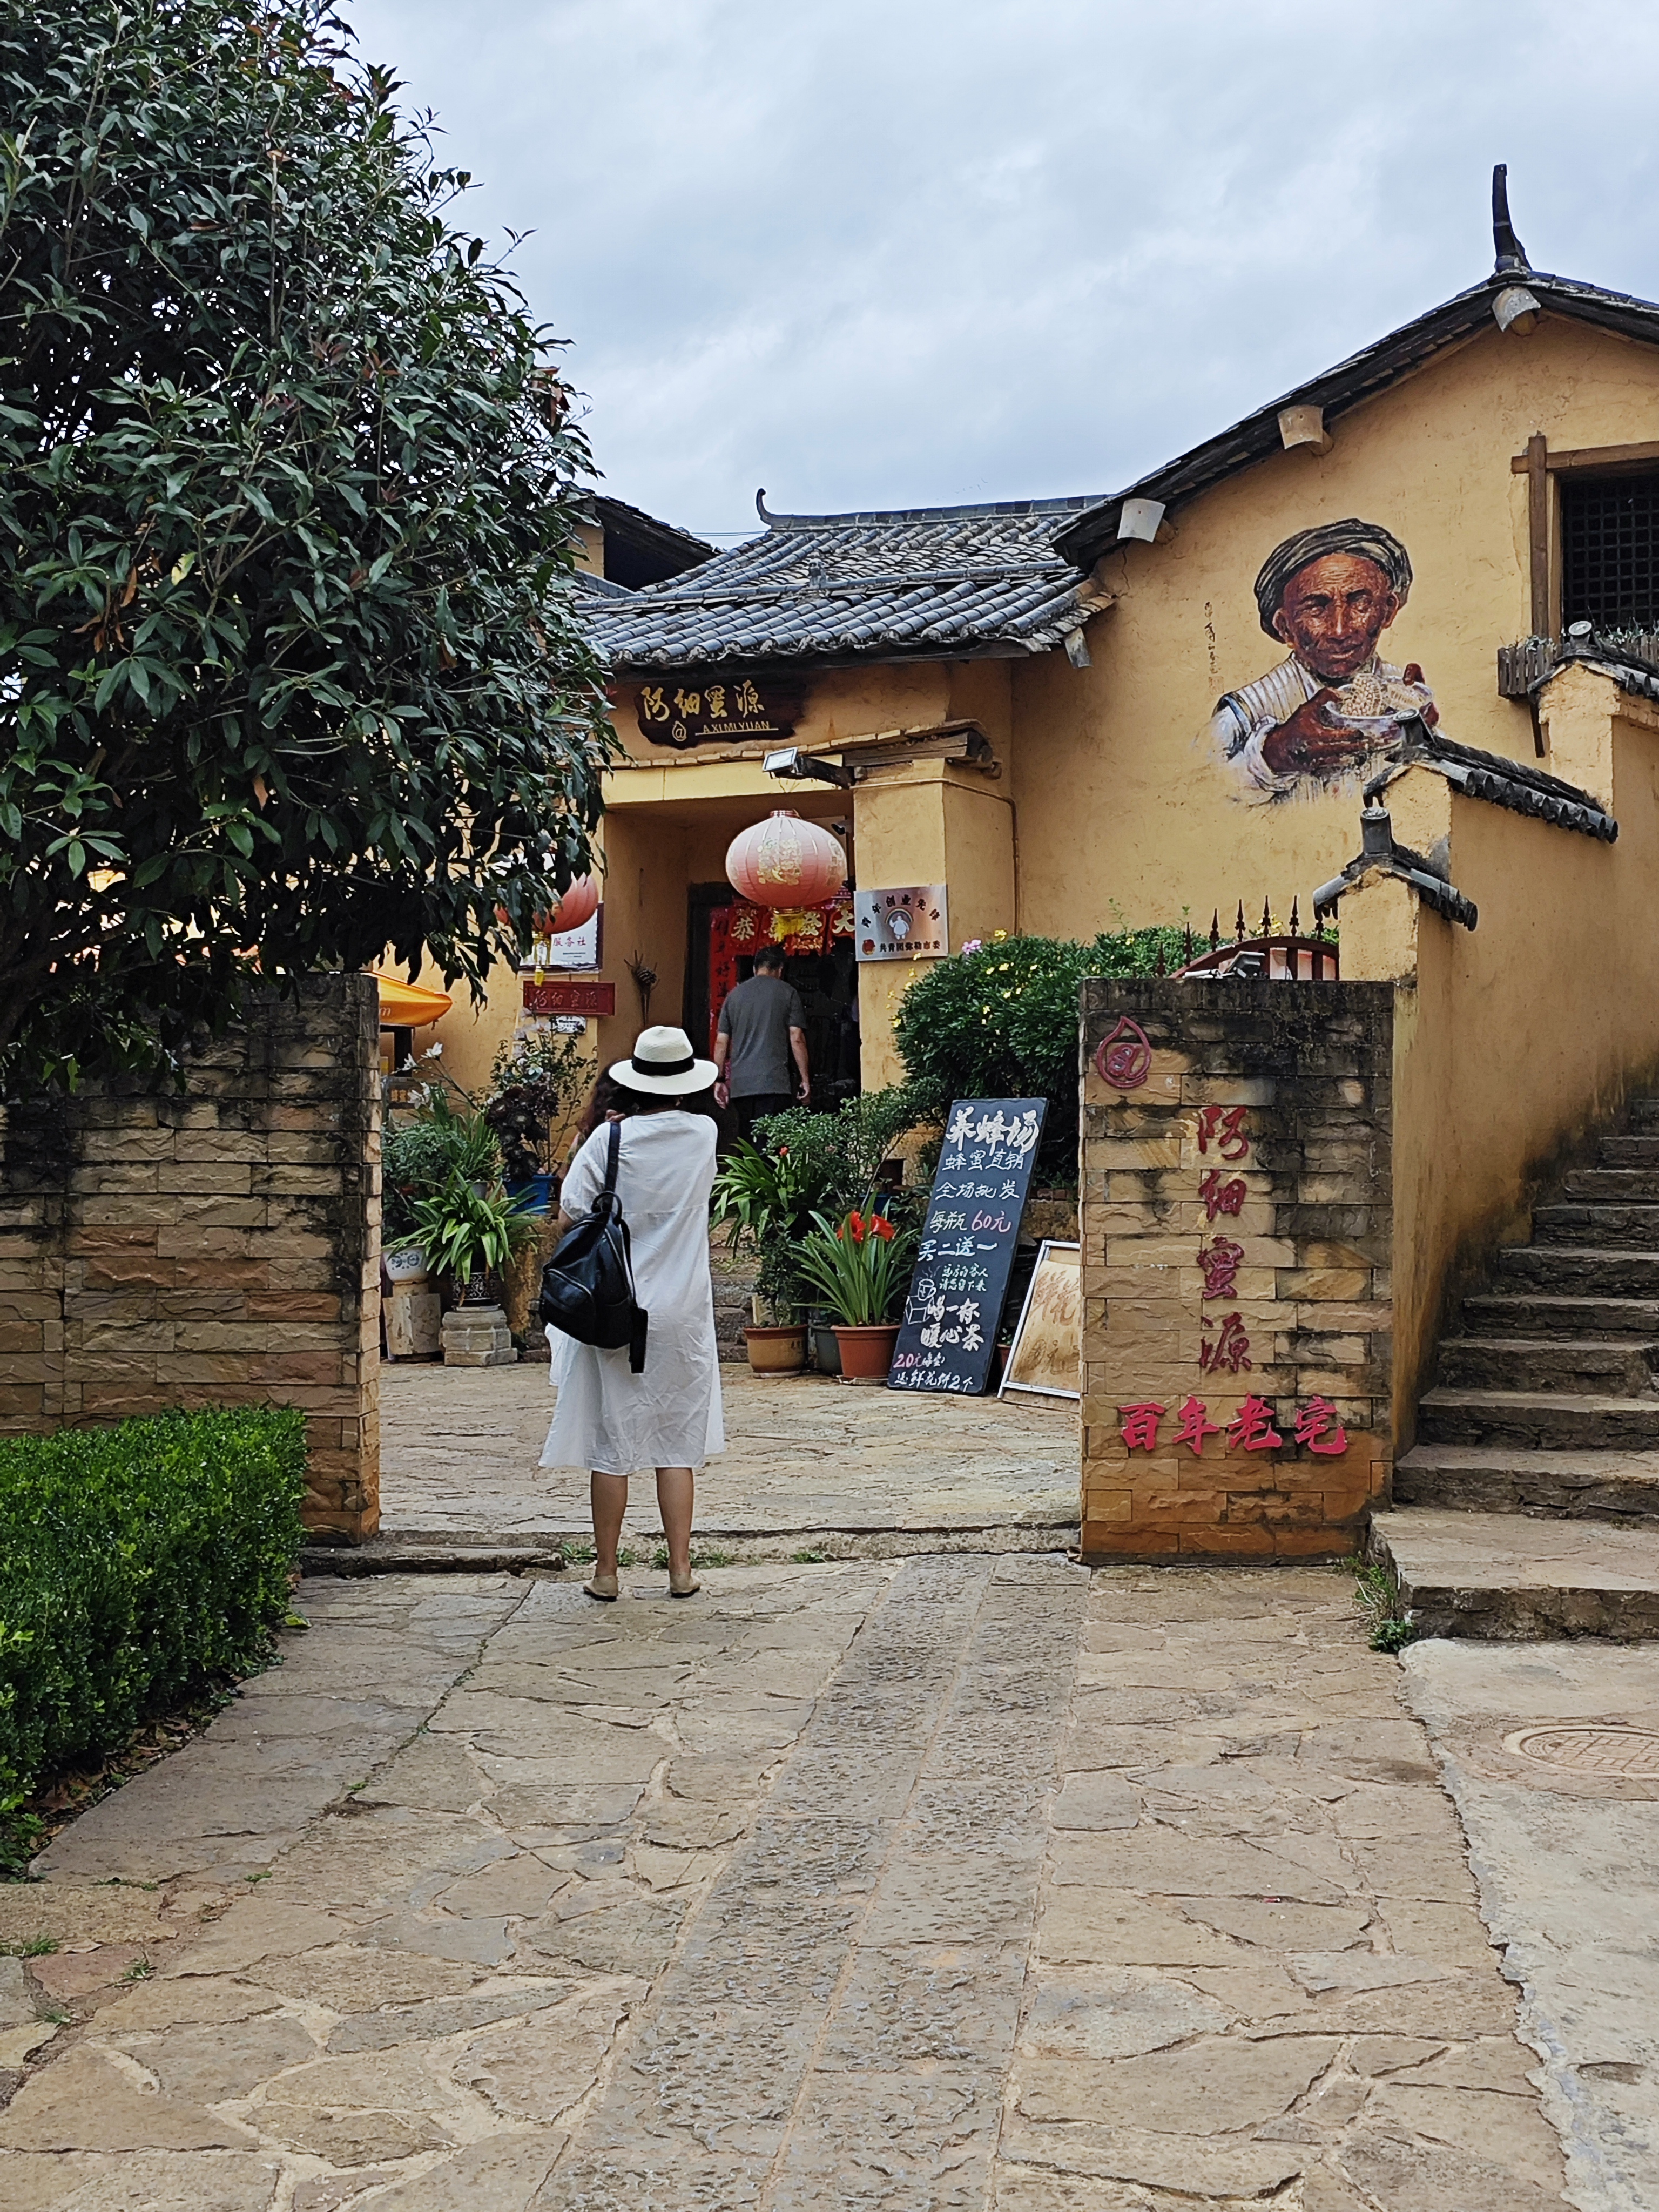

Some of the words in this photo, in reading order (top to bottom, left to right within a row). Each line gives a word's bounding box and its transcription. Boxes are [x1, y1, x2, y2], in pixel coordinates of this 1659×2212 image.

[703, 724, 710, 733] A
[711, 724, 722, 733] XI
[724, 722, 738, 732] MI
[738, 721, 769, 731] YUAN
[552, 936, 587, 947] 服务社
[879, 940, 941, 953] 共青团弥勒市委
[946, 1106, 1040, 1156] 养蜂场
[942, 1149, 1024, 1171] 蜂蜜直销
[935, 1179, 1020, 1201] 全场批发
[918, 1235, 997, 1262] 买二送一
[1196, 1105, 1253, 1374] 阿细蜜源
[942, 1263, 988, 1277] 远方的客人
[927, 1294, 981, 1324] 喝一杯
[920, 1322, 984, 1351] 暖心茶
[894, 1368, 974, 1392] 送鲜花饼2个
[1117, 1392, 1350, 1455] 百年老宅
